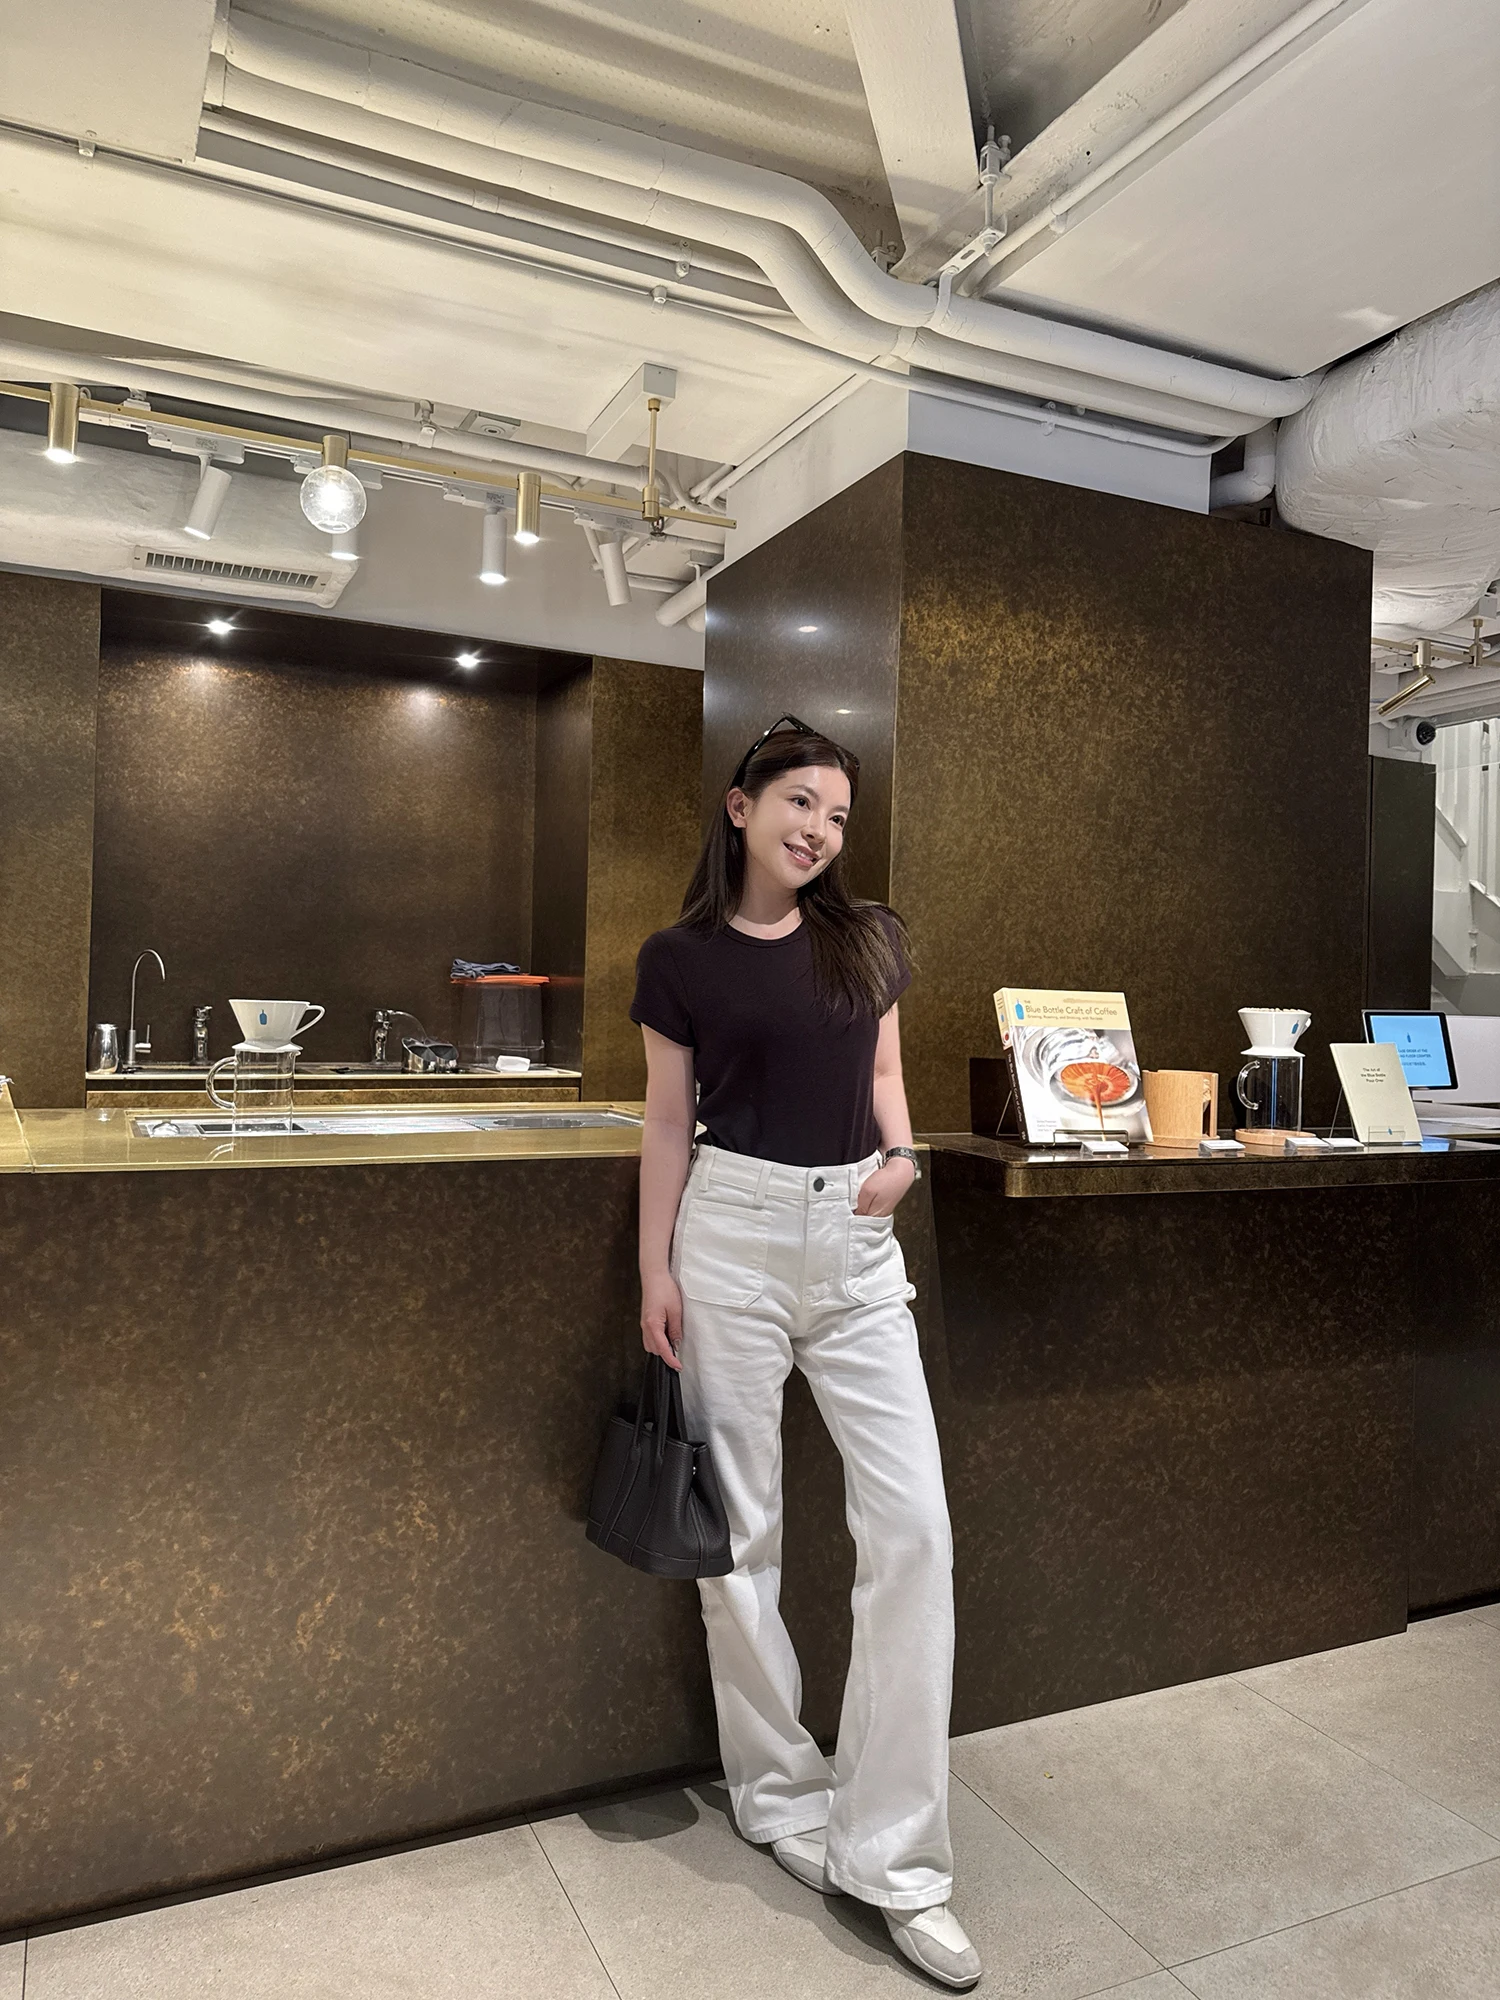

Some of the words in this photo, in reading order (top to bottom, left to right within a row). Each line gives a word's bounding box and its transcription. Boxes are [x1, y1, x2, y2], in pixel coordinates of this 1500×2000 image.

[1043, 1006, 1064, 1014] Bottle
[1066, 1007, 1084, 1015] Craft
[1085, 1007, 1093, 1015] of
[1094, 1007, 1118, 1016] Coffee
